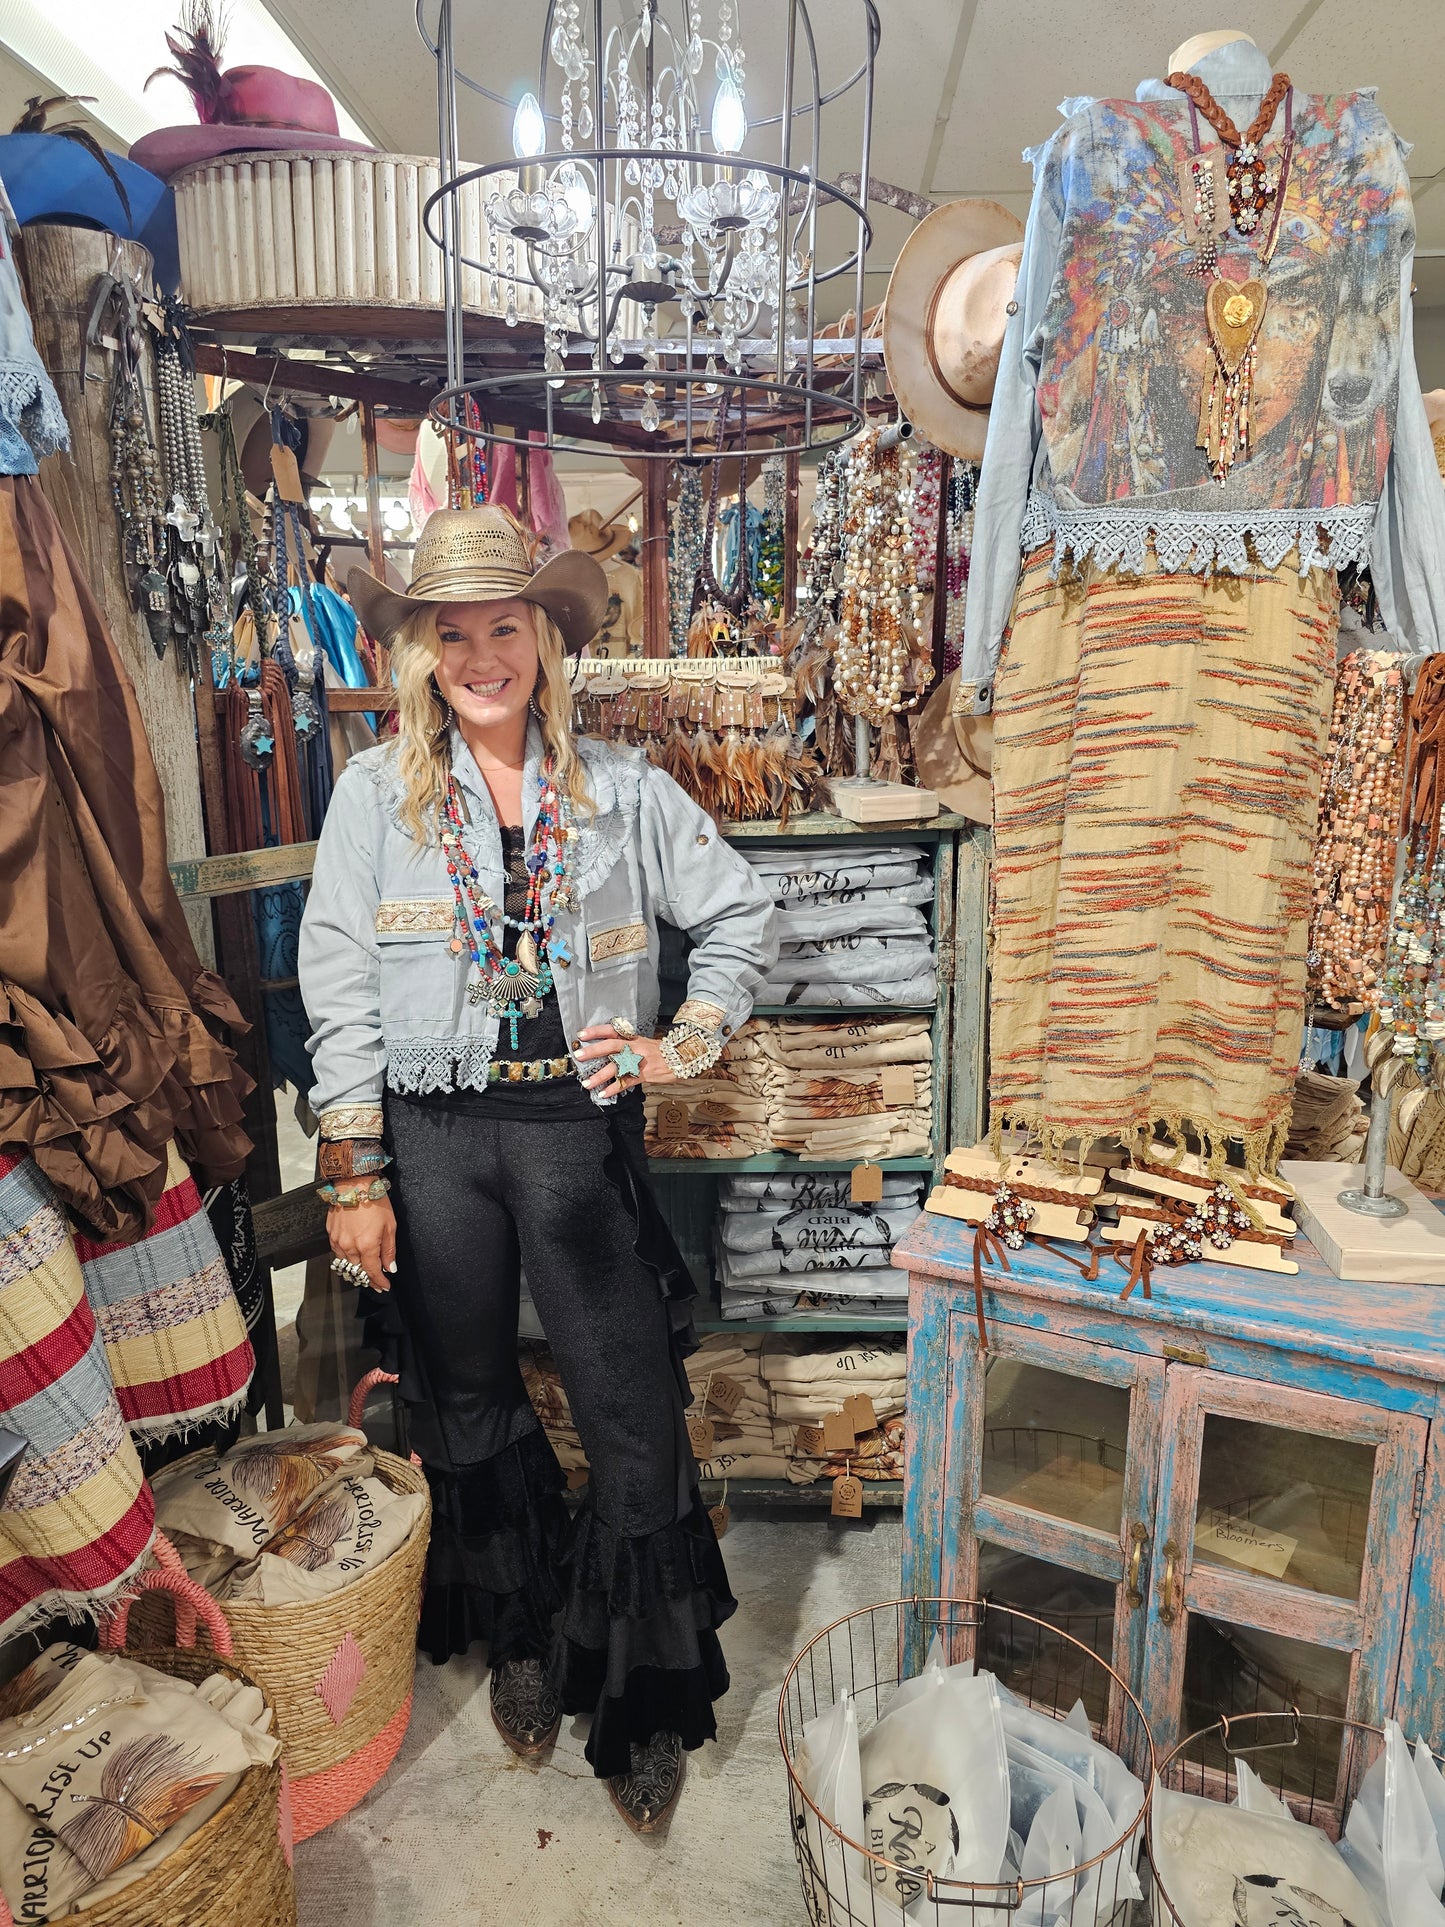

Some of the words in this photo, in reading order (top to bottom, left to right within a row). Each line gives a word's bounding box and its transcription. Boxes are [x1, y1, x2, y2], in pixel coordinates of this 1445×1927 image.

[808, 1215, 851, 1225] BIRD
[1216, 1528, 1285, 1552] Bloomers
[26, 1761, 81, 1822] RISE
[924, 1841, 937, 1856] A
[12, 1827, 60, 1927] ARRIOR
